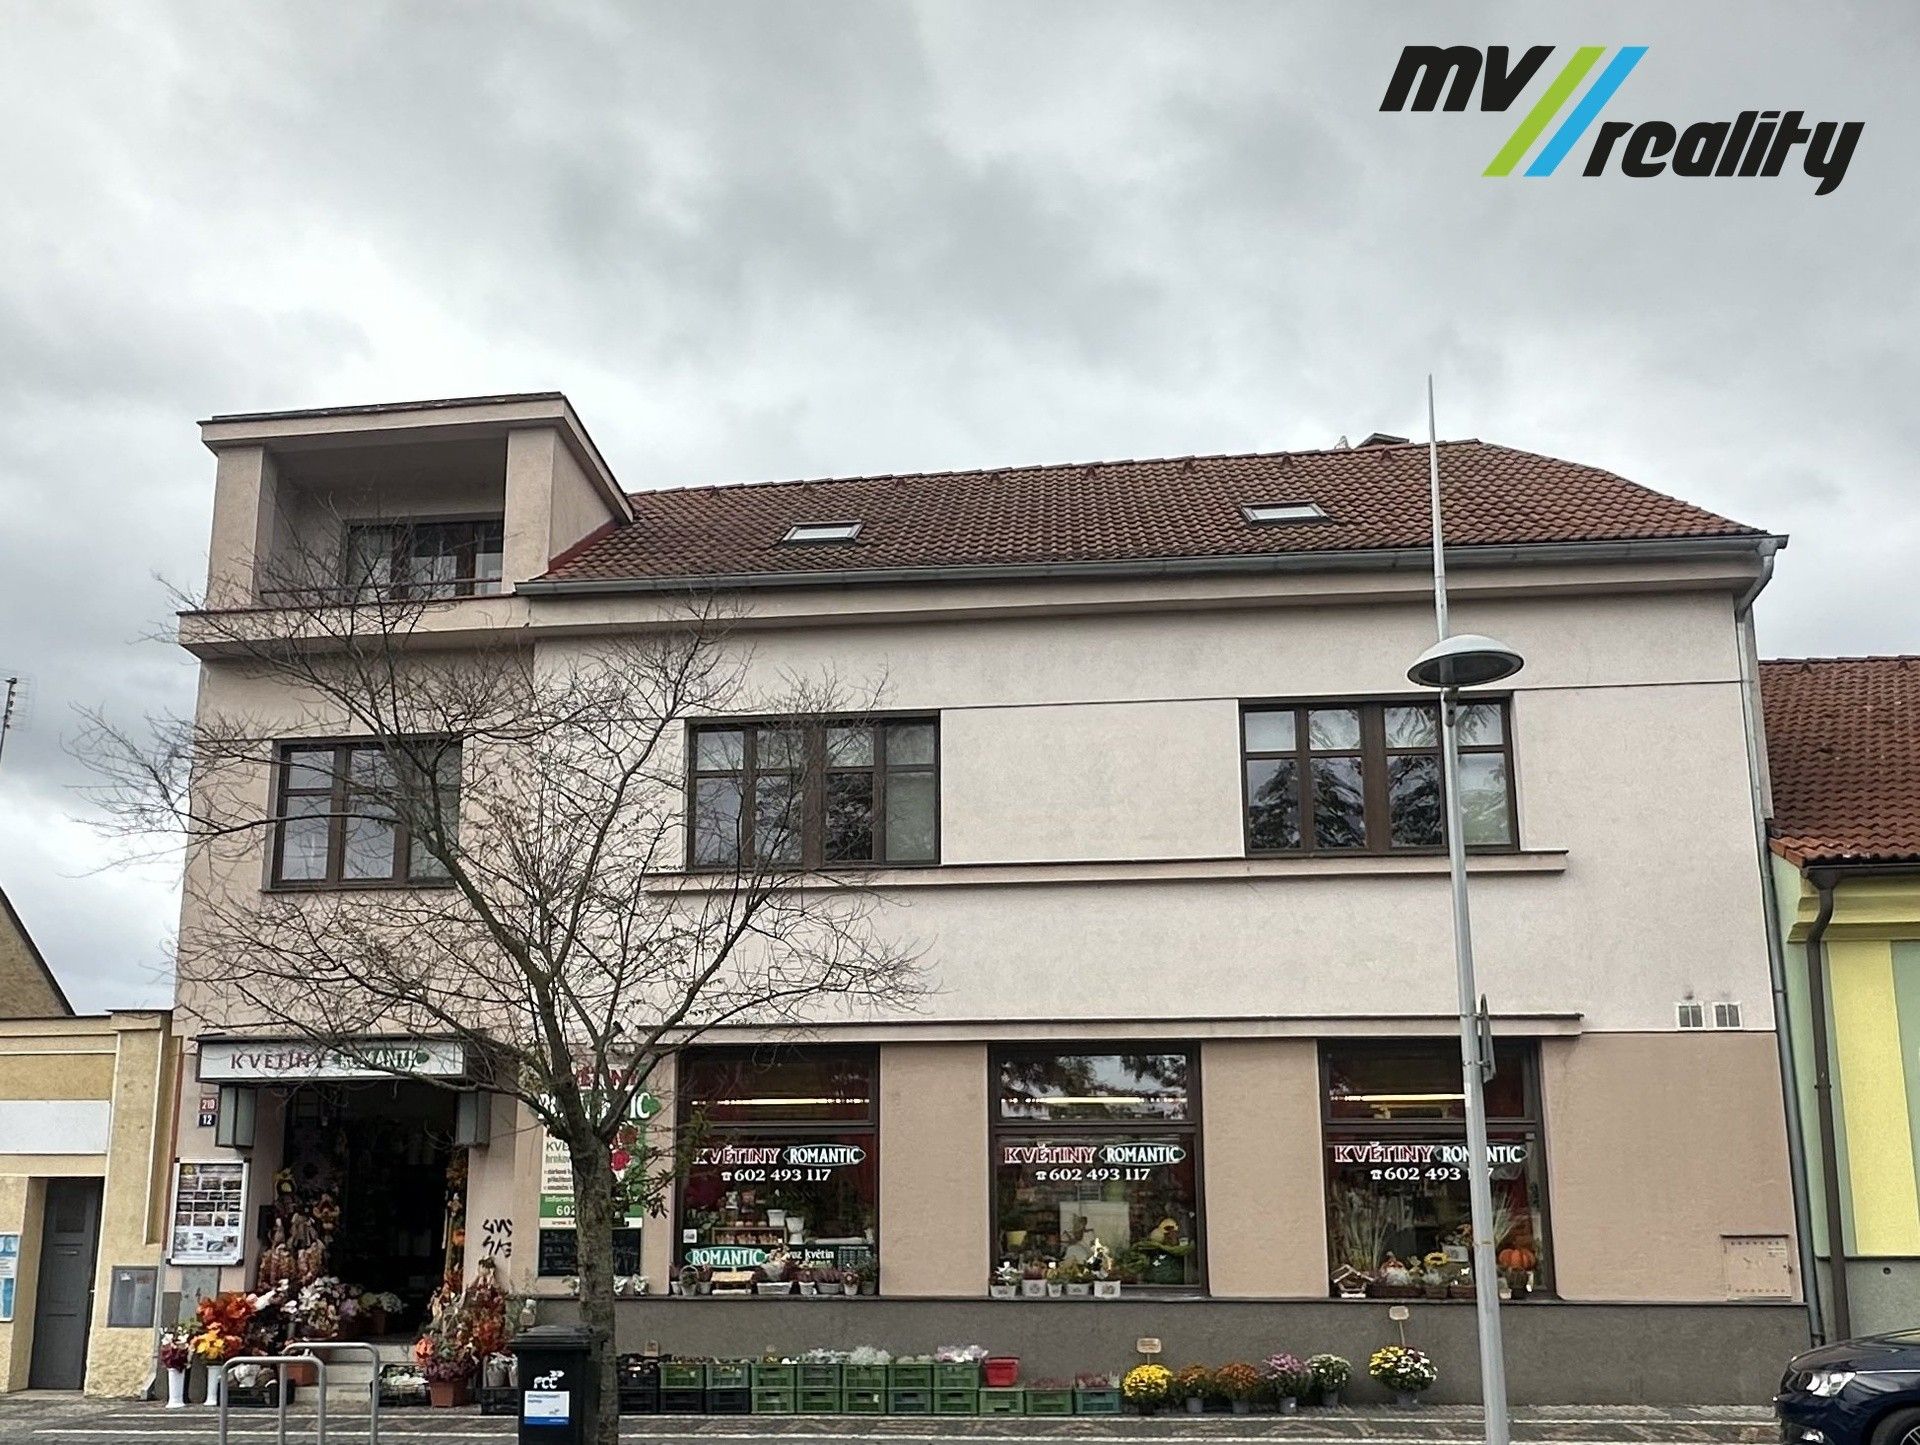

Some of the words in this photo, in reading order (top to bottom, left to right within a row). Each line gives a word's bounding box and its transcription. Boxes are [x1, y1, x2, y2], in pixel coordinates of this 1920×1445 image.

[203, 1114, 212, 1125] 12
[789, 1147, 861, 1164] ROMANTIC
[1004, 1144, 1098, 1164] KVĚTINY
[1106, 1146, 1179, 1164] ROMANTIC
[1334, 1142, 1435, 1163] KVĚTINY
[734, 1169, 766, 1182] 602
[770, 1169, 802, 1182] 493
[807, 1169, 832, 1182] 117
[1049, 1168, 1082, 1181] 602
[1086, 1168, 1120, 1181] 493
[1125, 1168, 1150, 1181] 117
[1384, 1167, 1420, 1181] 602
[1425, 1167, 1461, 1181] 493
[692, 1249, 761, 1266] ROMANTIC
